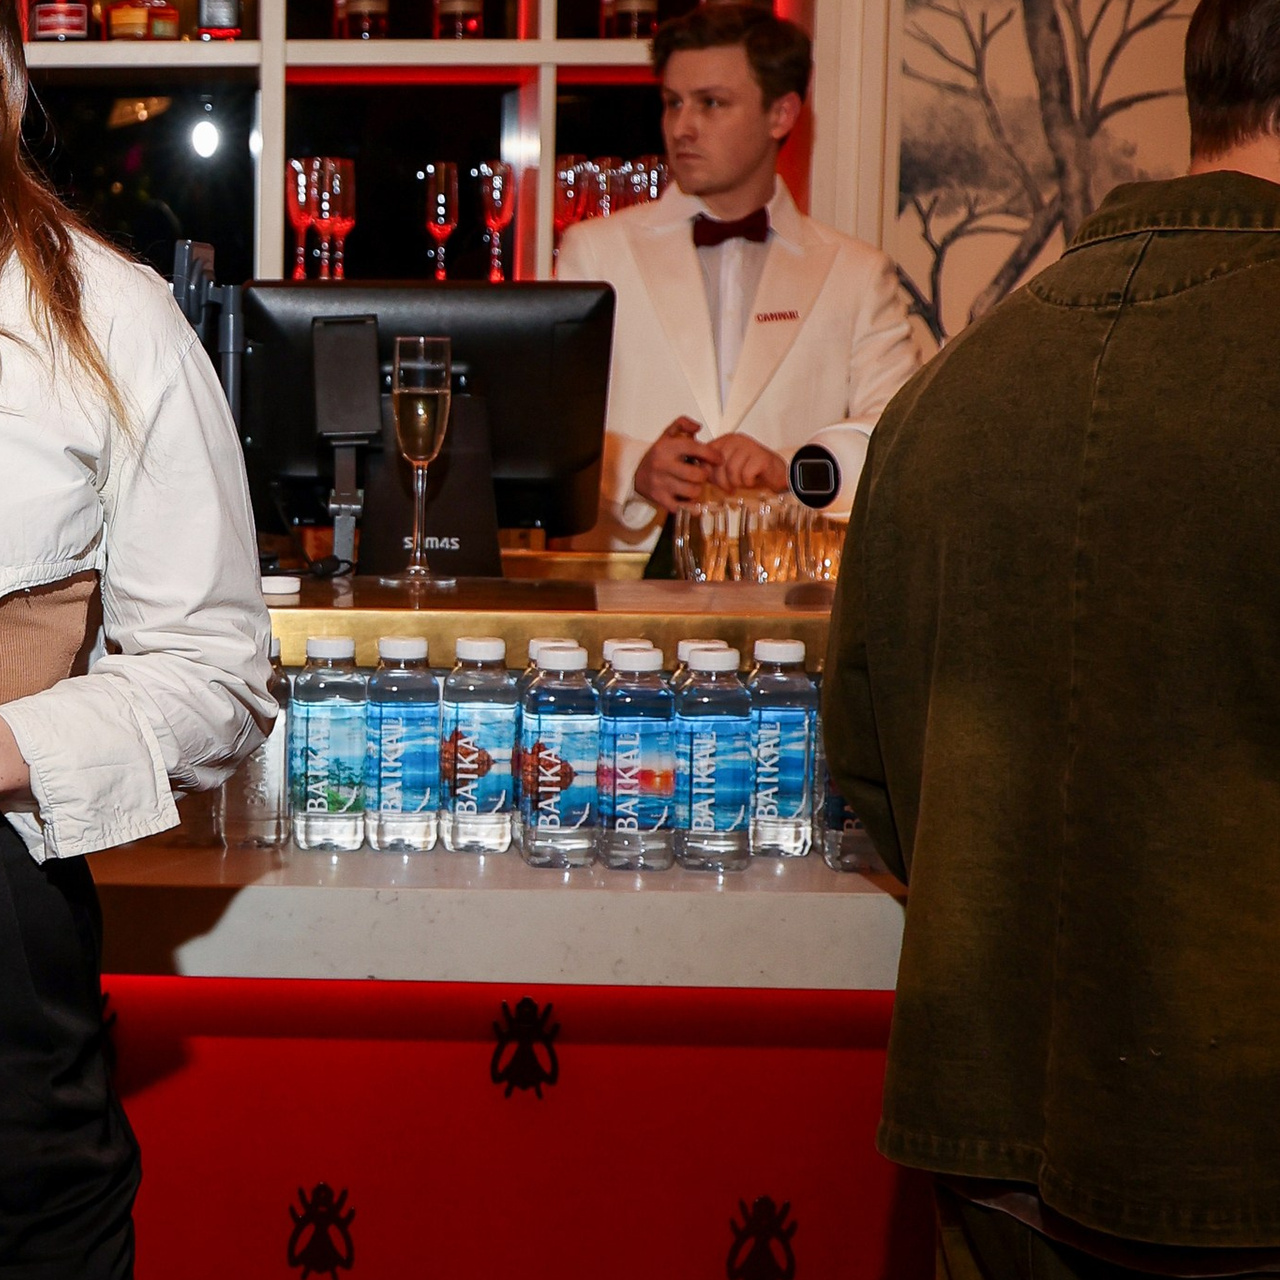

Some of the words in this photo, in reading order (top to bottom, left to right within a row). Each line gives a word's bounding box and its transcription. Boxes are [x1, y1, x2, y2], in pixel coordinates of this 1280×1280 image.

[380, 716, 403, 813] BAIKAL
[455, 720, 480, 815] BAIKAL
[537, 729, 562, 830] BAIKAL
[615, 732, 641, 833] BAIKAL
[692, 730, 717, 832] BAIKAL
[755, 721, 780, 820] BAIKAL
